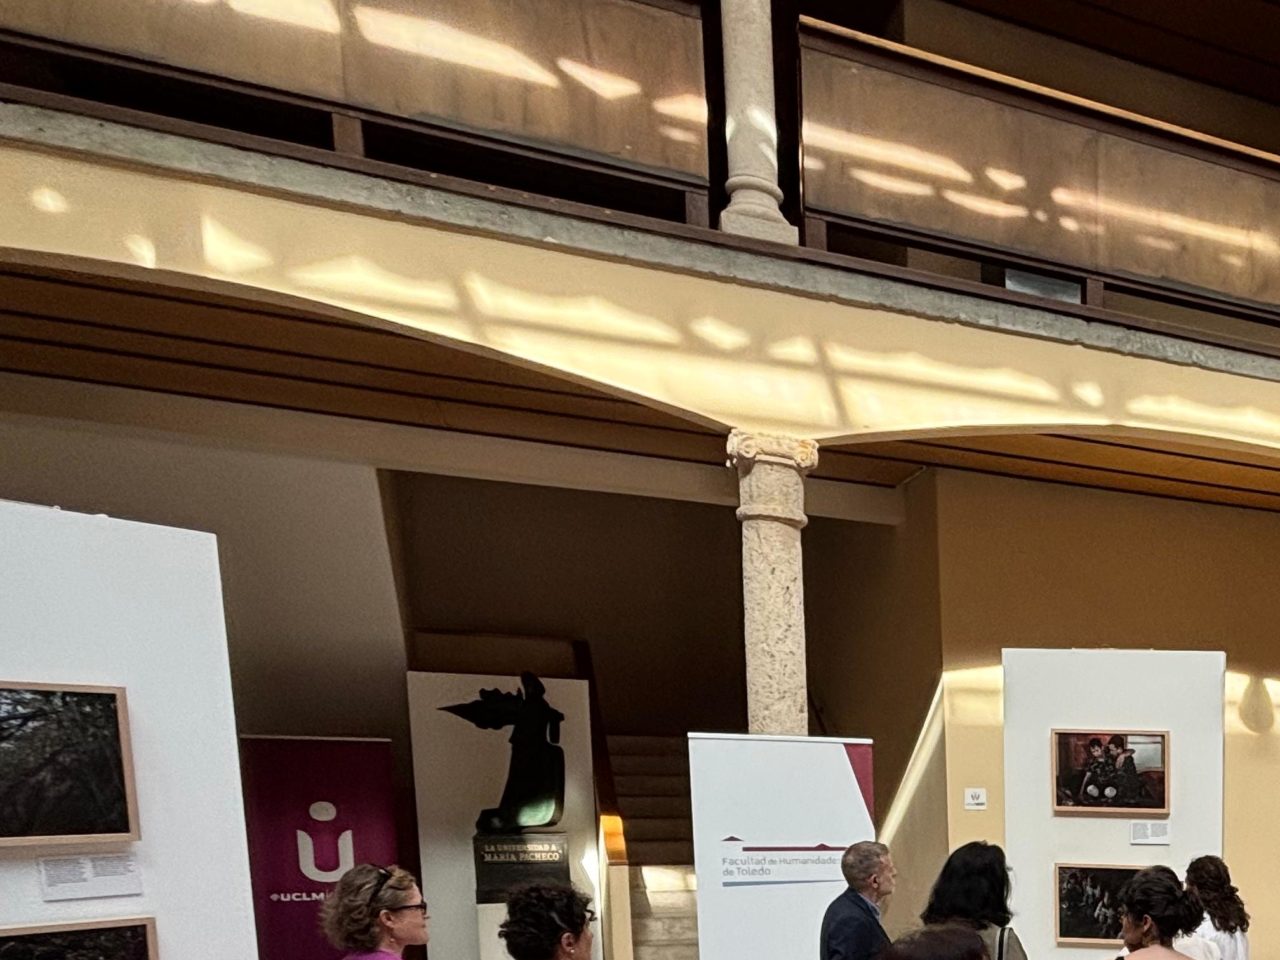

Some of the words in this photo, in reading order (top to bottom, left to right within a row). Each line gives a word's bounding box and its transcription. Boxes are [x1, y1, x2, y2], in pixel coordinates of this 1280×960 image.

[519, 852, 560, 861] PACHECO
[722, 856, 767, 866] Facultad
[767, 858, 777, 866] de
[722, 868, 735, 877] de
[736, 867, 772, 877] Toledo
